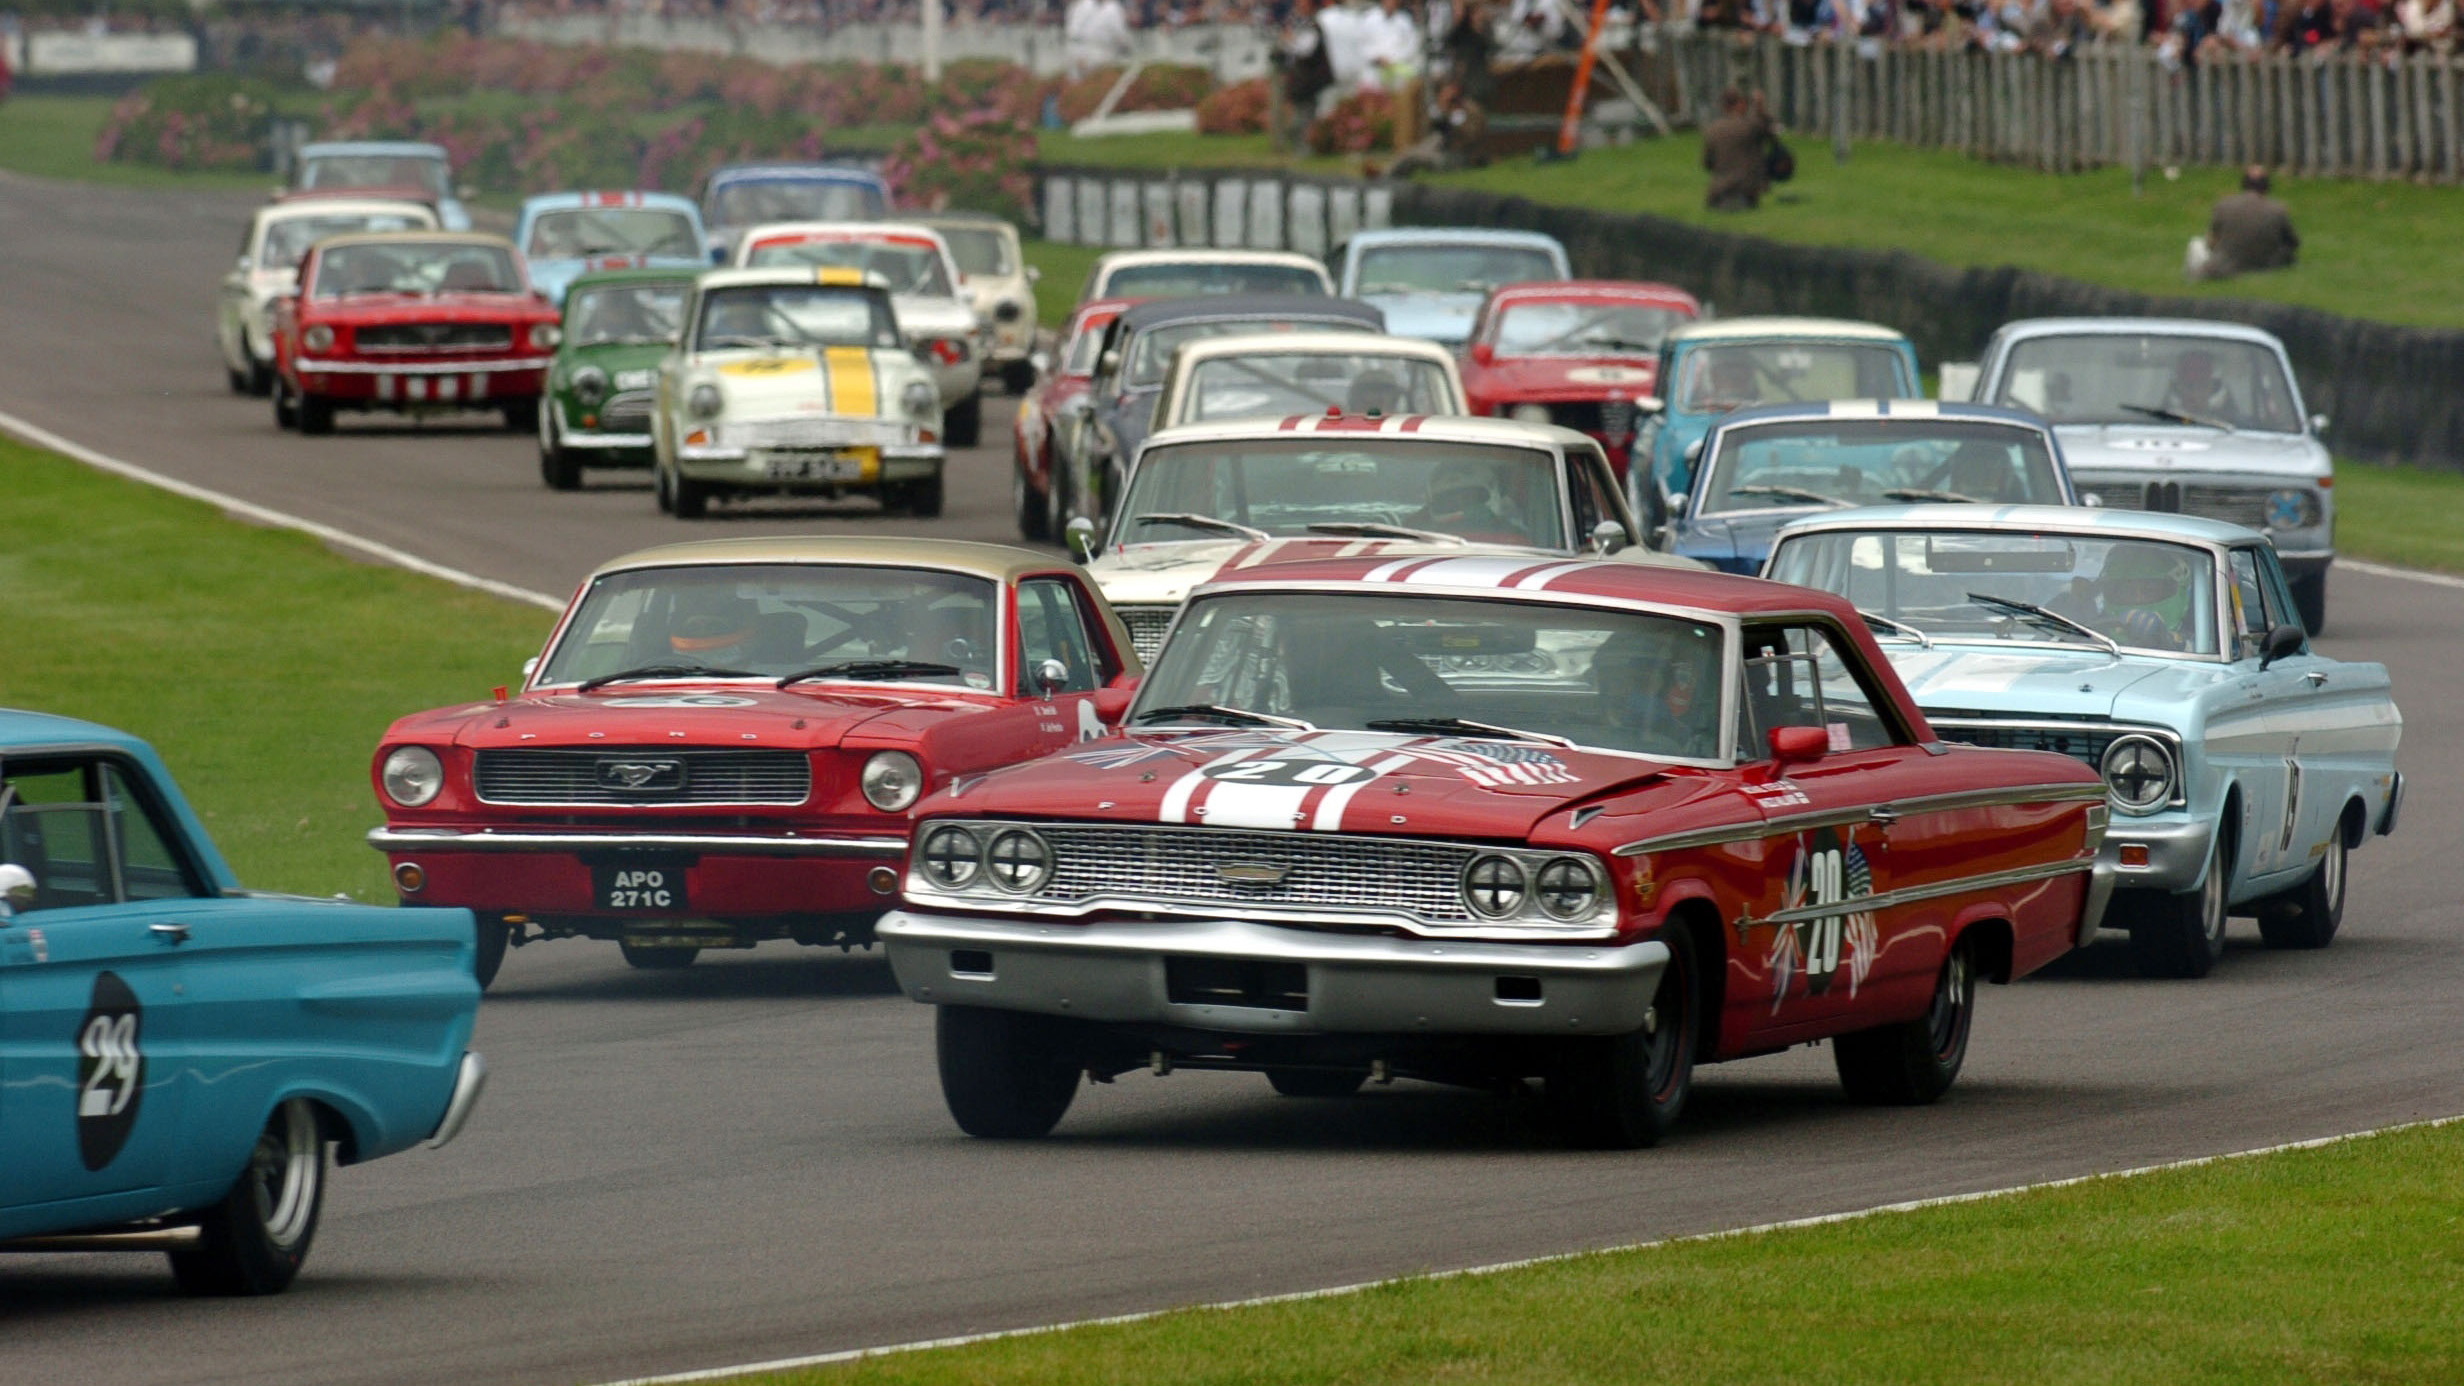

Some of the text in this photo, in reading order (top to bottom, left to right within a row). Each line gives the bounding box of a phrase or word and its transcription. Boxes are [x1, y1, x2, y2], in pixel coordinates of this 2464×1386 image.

[1213, 761, 1365, 785] 20
[1098, 801, 1407, 824] FORD
[615, 870, 664, 888] APO
[610, 890, 671, 907] 271C
[1806, 849, 1842, 974] 20
[78, 1013, 139, 1116] 29
